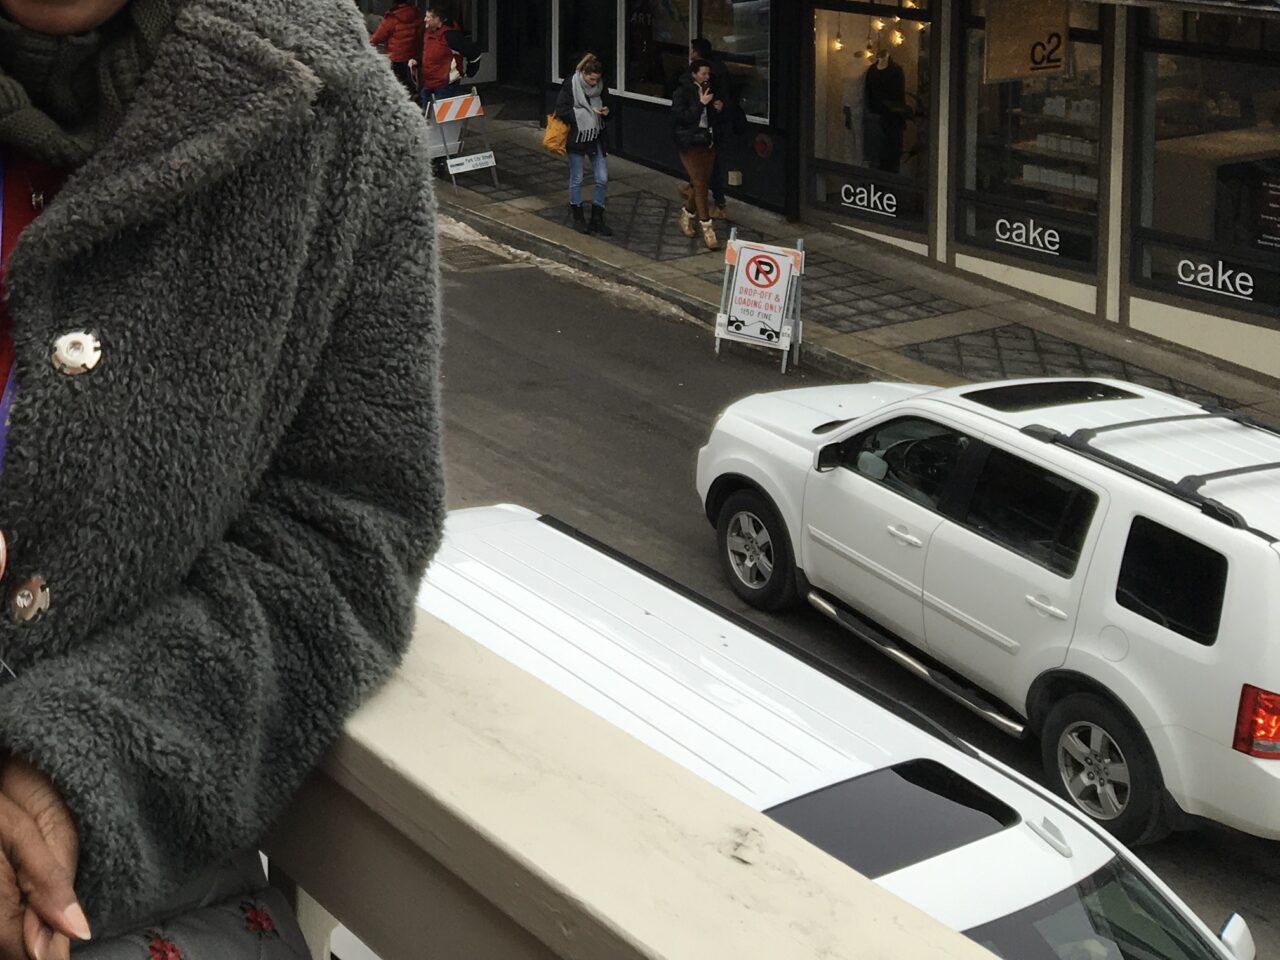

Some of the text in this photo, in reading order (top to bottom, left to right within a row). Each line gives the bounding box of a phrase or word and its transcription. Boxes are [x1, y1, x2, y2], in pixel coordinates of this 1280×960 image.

[1030, 32, 1062, 66] c2
[841, 183, 897, 213] cake
[995, 218, 1060, 251] cake
[1177, 258, 1254, 295] cake
[735, 296, 783, 313] LOADING ONLY
[757, 311, 773, 320] FINE
